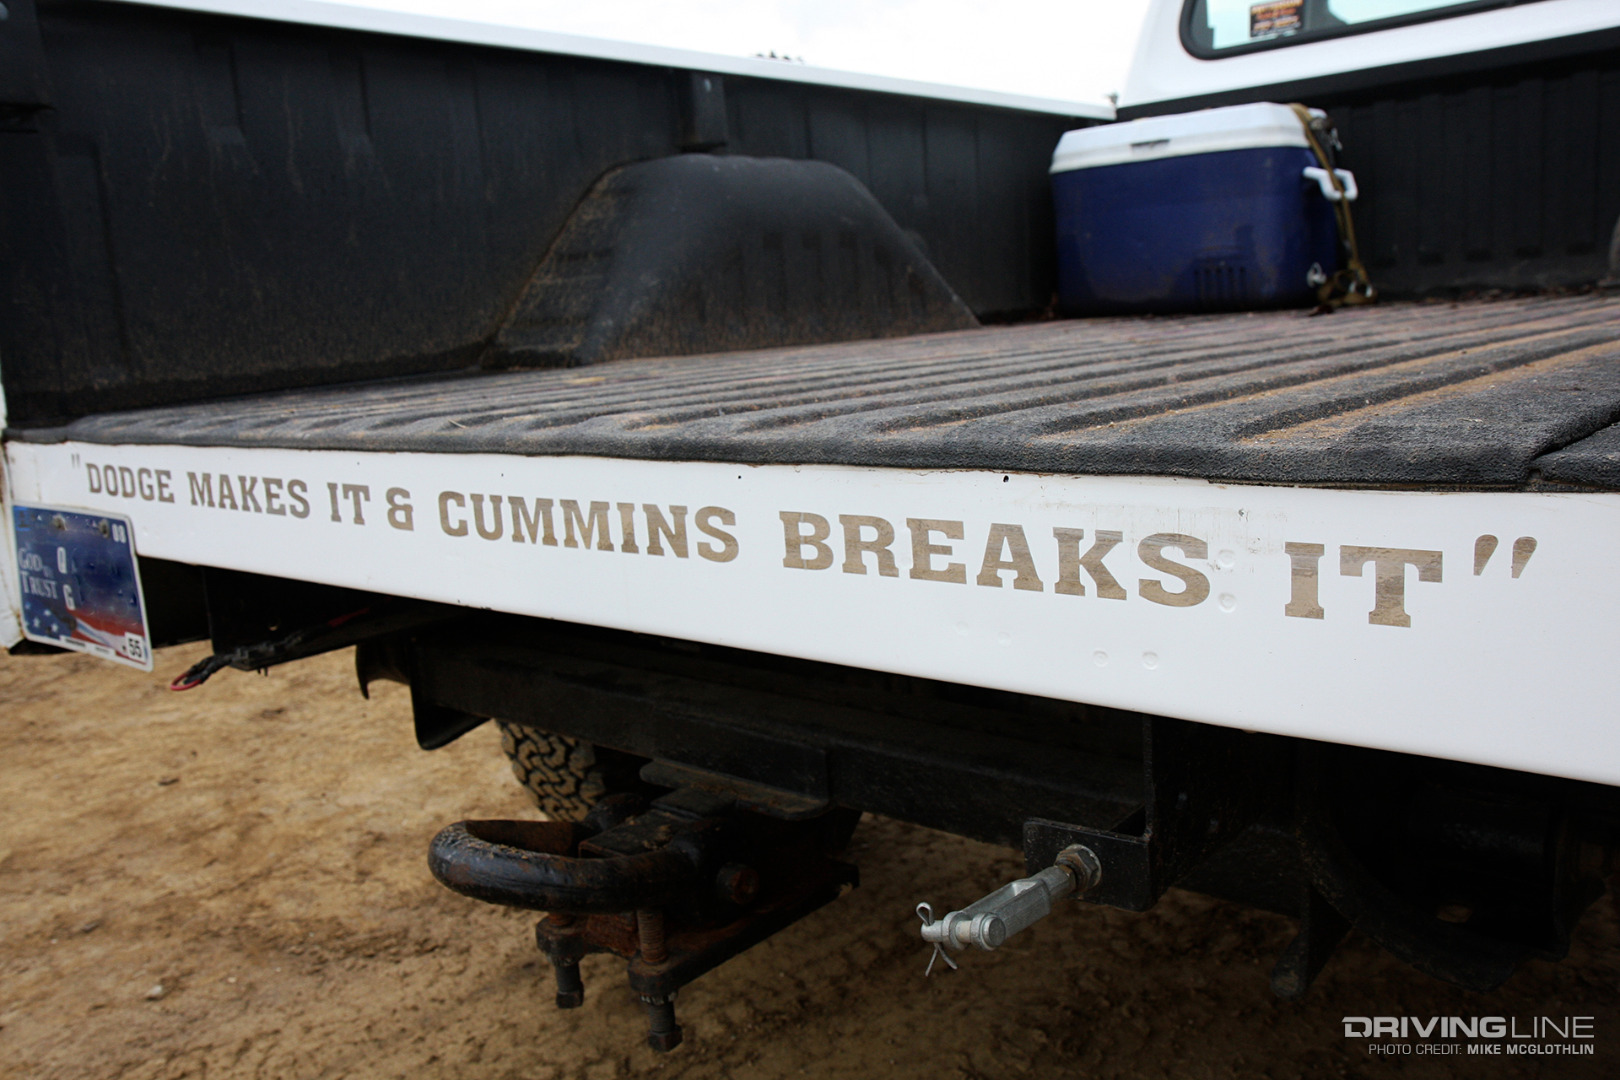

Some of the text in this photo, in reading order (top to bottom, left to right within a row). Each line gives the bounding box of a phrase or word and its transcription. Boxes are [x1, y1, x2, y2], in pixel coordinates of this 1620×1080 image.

[187, 472, 310, 518] MAKES
[327, 483, 370, 525] IT
[386, 488, 413, 530] &
[439, 491, 738, 562] CUMMINS
[780, 511, 1210, 607] BREAKS
